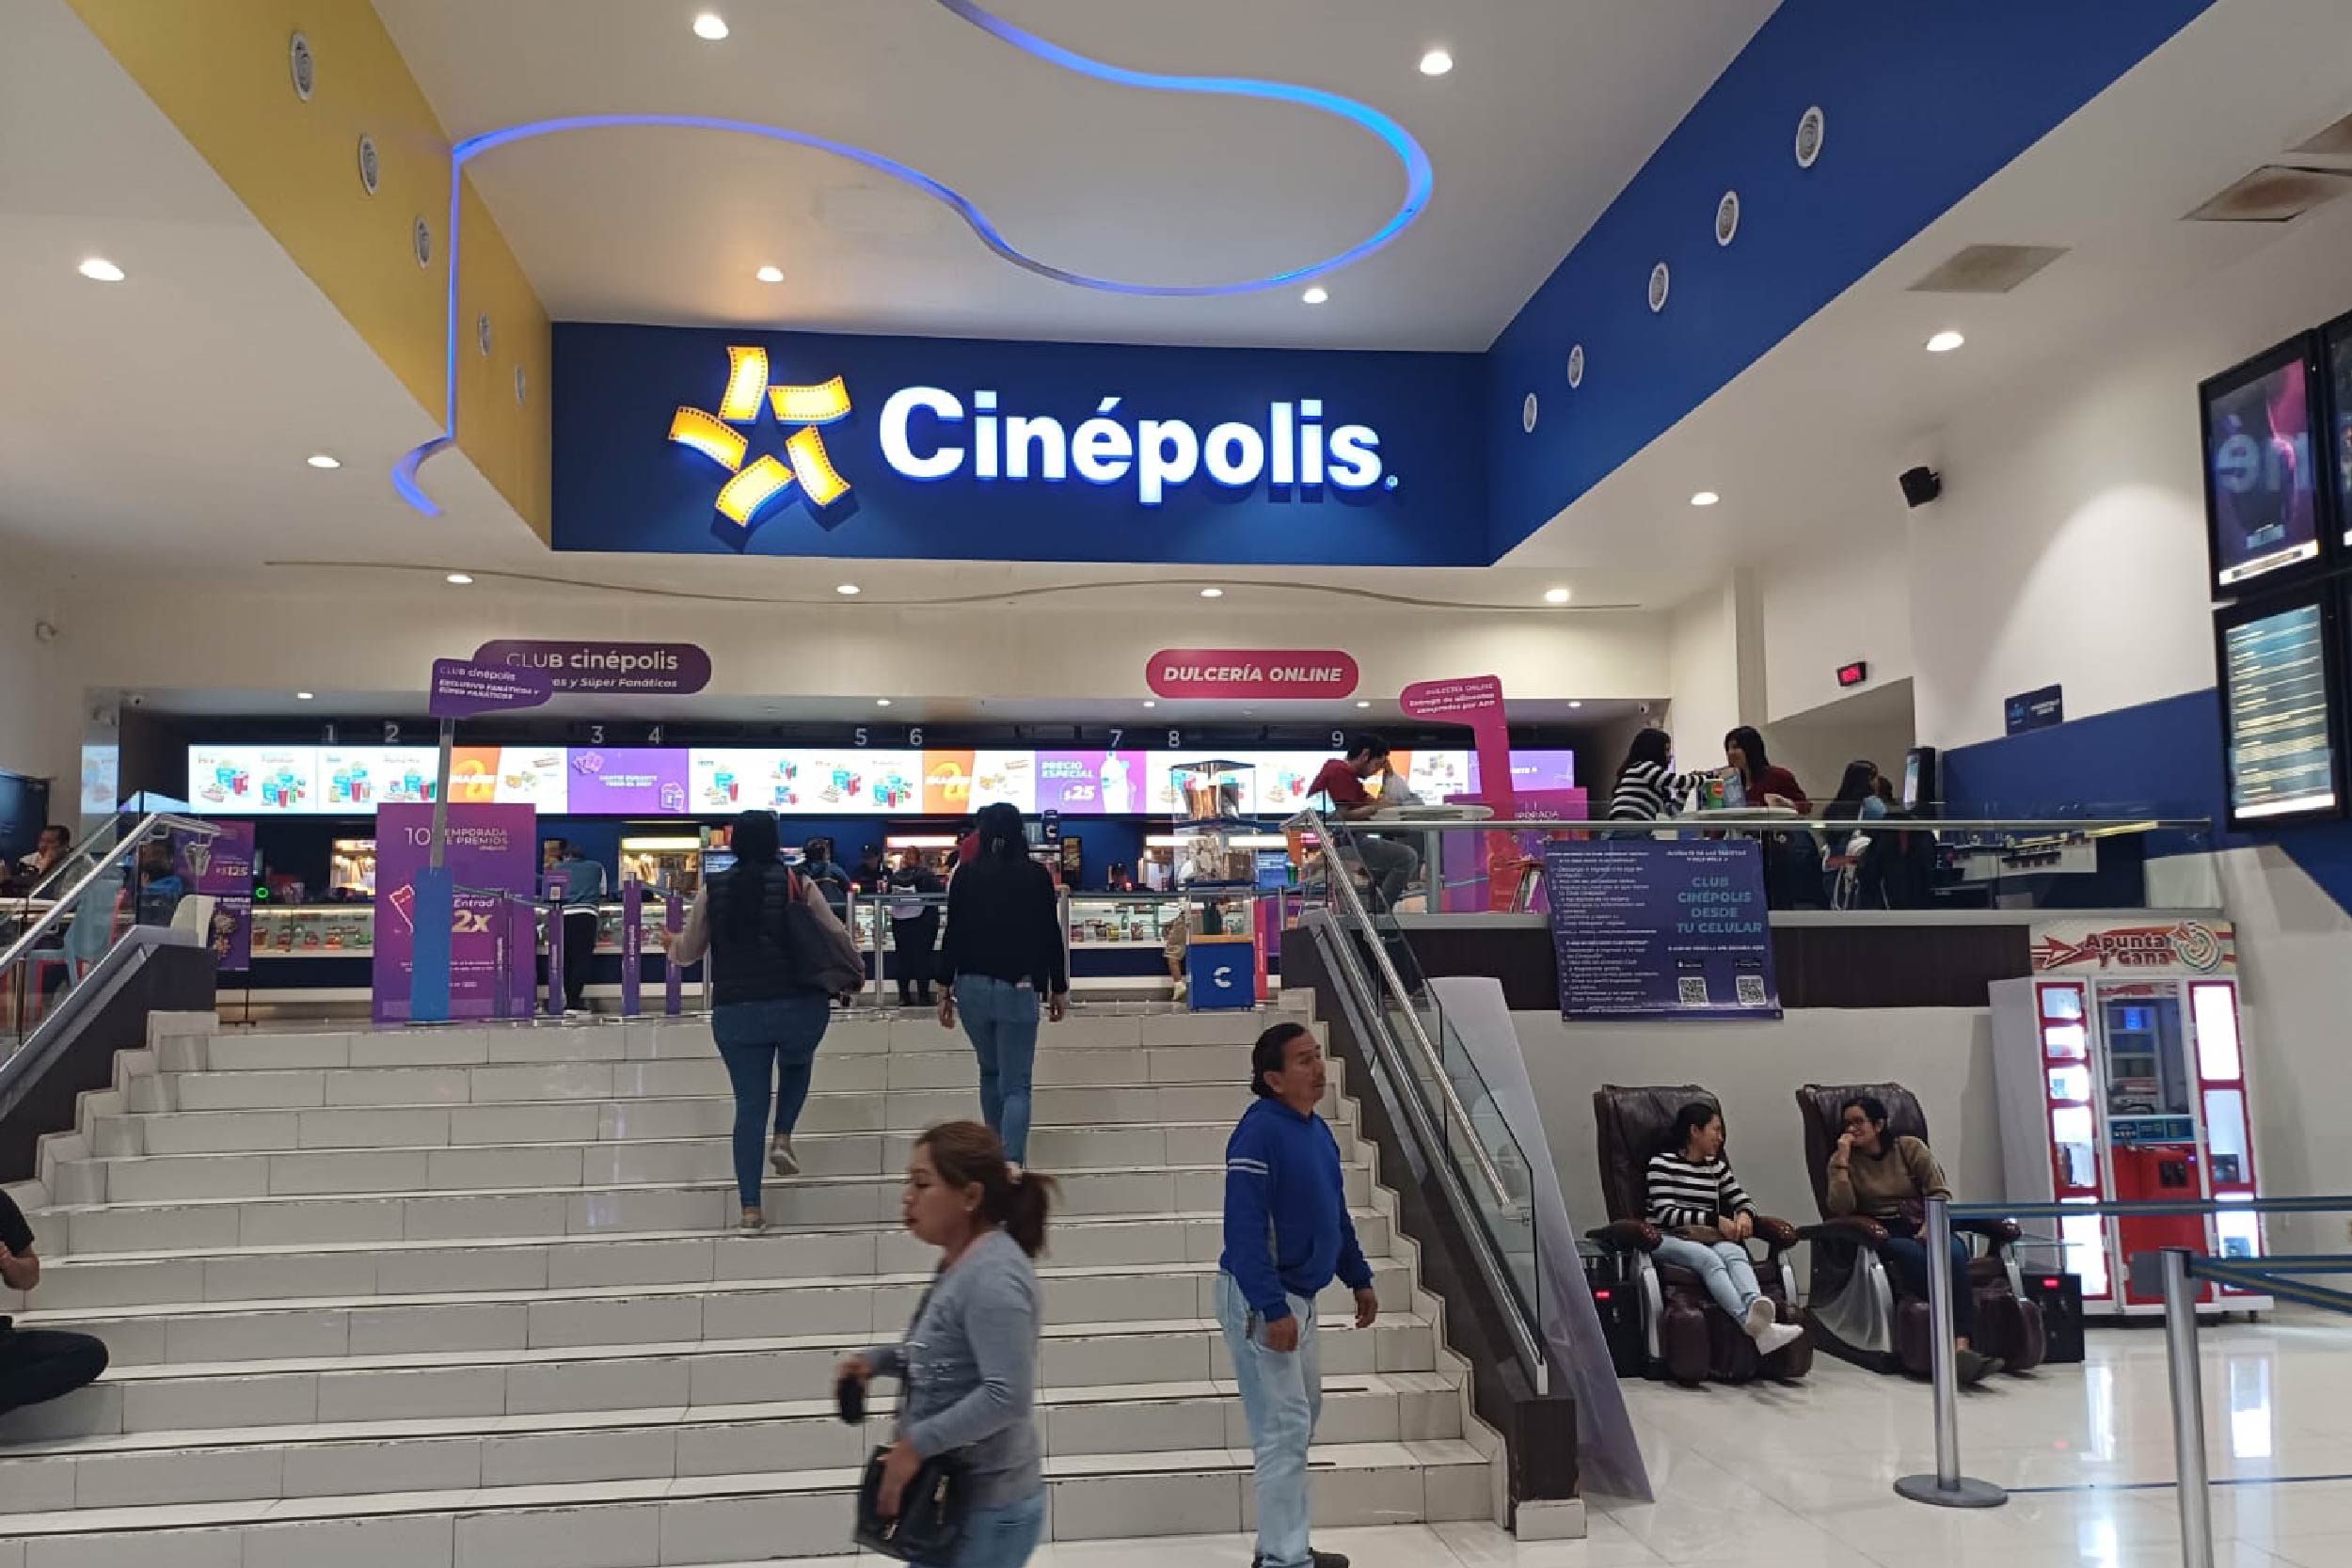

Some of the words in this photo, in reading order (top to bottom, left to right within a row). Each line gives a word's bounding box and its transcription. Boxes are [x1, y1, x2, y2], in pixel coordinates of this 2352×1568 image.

[880, 386, 1383, 505] Cinépolis
[506, 653, 564, 668] CLUB
[571, 649, 678, 673] cinépolis
[1164, 663, 1263, 682] DULCERÍA
[1269, 667, 1343, 682] ONLINE
[618, 678, 677, 688] Fanáticos
[385, 724, 400, 743] 2
[591, 725, 604, 744] 3
[648, 725, 662, 744] 4
[854, 728, 867, 746] 5
[910, 728, 923, 746] 6
[1109, 729, 1122, 748] 7
[1168, 731, 1180, 748] 8
[1331, 732, 1344, 749] 9
[444, 828, 508, 836] EMPORADA
[1692, 878, 1729, 888] CLUB
[1677, 891, 1752, 903] CINÉPOLIS
[1692, 908, 1739, 918] DESDE
[1677, 923, 1694, 934] TU
[1698, 923, 1762, 934] CELULAR
[2118, 951, 2169, 966] Gana
